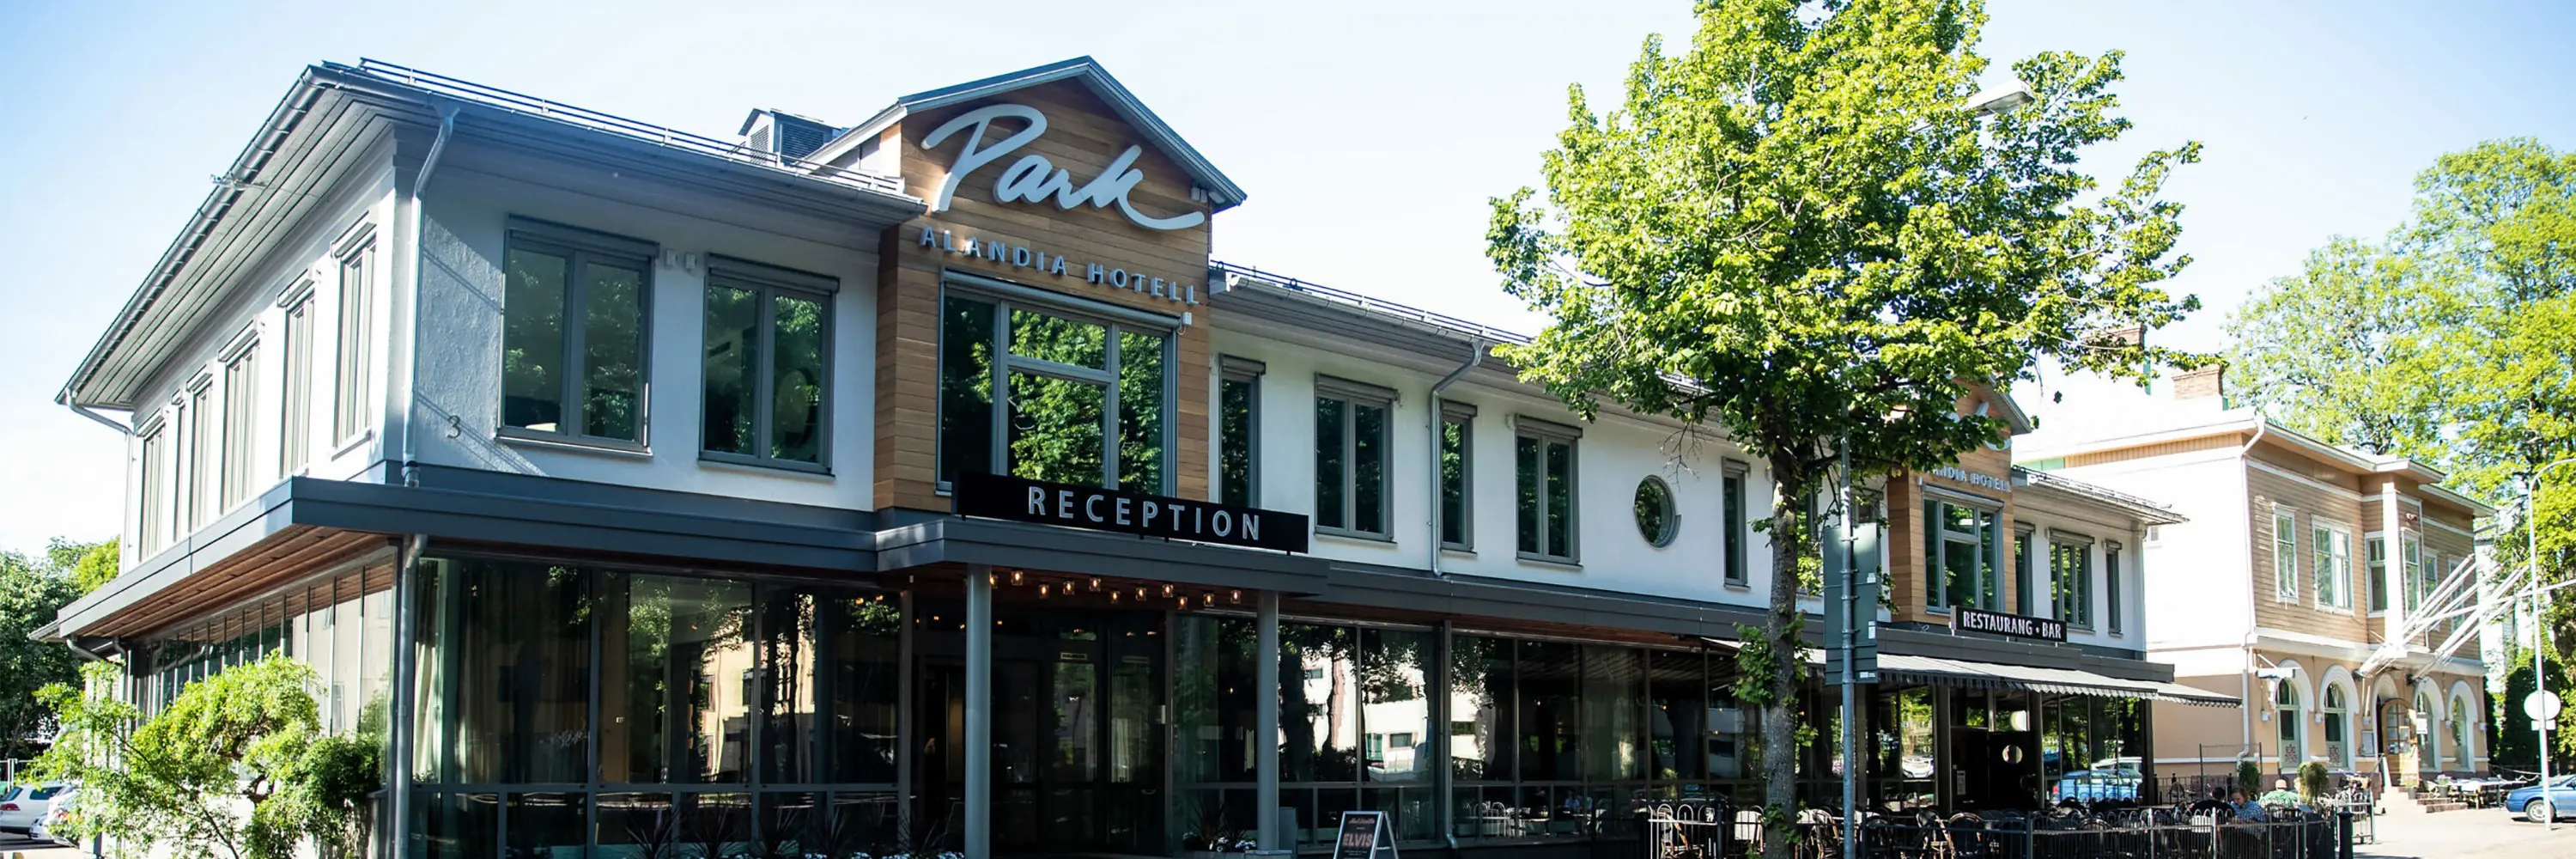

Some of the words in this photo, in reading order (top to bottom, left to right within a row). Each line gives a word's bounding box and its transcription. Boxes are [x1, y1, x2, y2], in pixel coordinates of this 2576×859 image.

[920, 104, 1205, 230] Park
[920, 226, 1067, 277] ALANDIA
[1086, 262, 1200, 306] HOTELL
[447, 415, 461, 439] 3
[1971, 472, 2011, 493] HOTELL
[1029, 485, 1260, 541] RECEPTION
[1963, 611, 2033, 636] RESTAURANG
[2042, 622, 2062, 639] BAR
[1342, 833, 1373, 847] ELVIS
